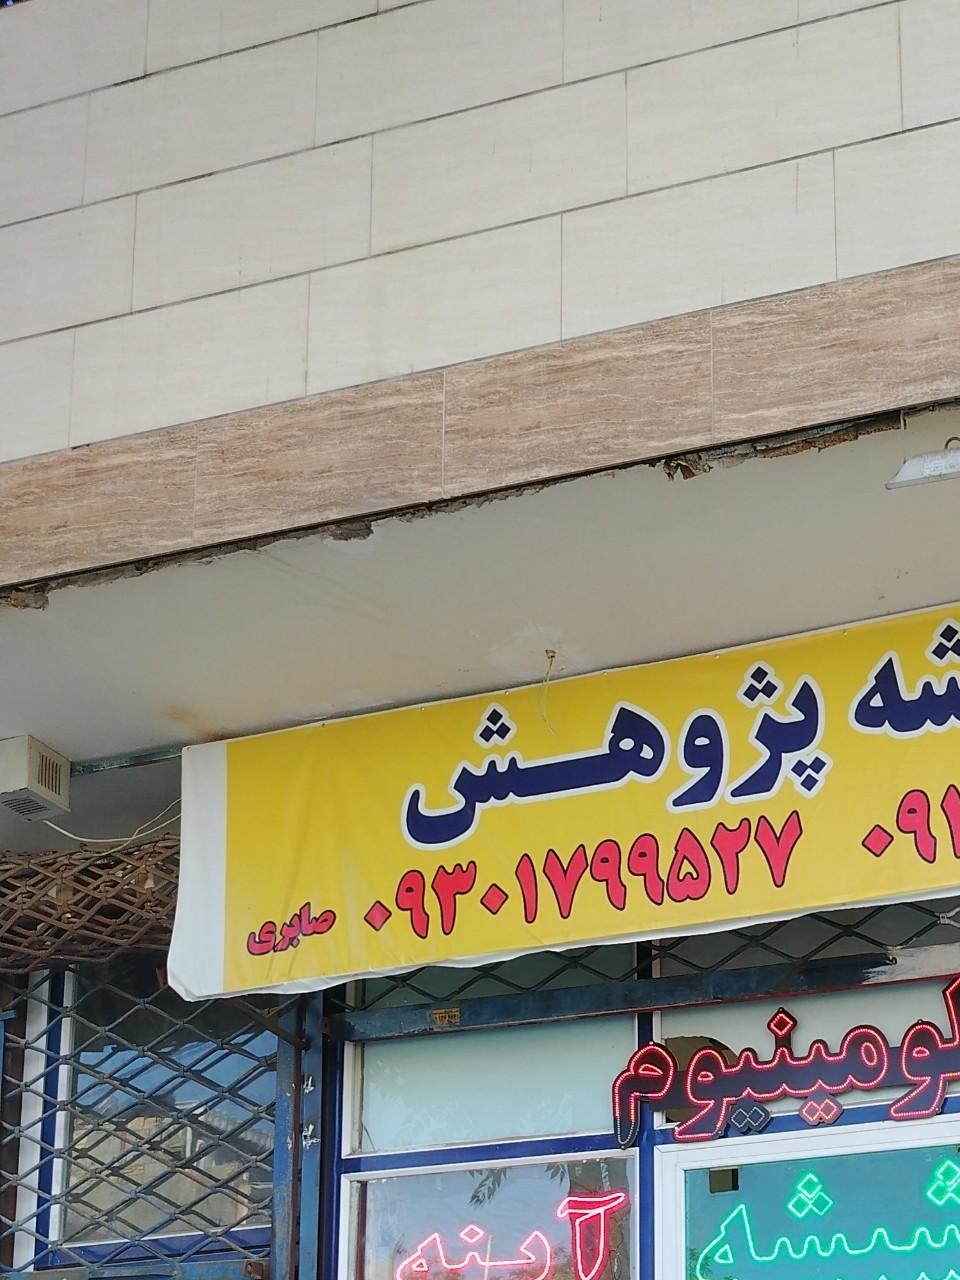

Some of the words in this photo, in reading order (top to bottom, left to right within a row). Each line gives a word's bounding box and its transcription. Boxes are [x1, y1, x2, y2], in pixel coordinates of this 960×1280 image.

[403, 662, 829, 847] پژوهش
[246, 901, 337, 956] صابری
[363, 809, 804, 940] ۰۹۳۰۱۷۹۹۵۲۷
